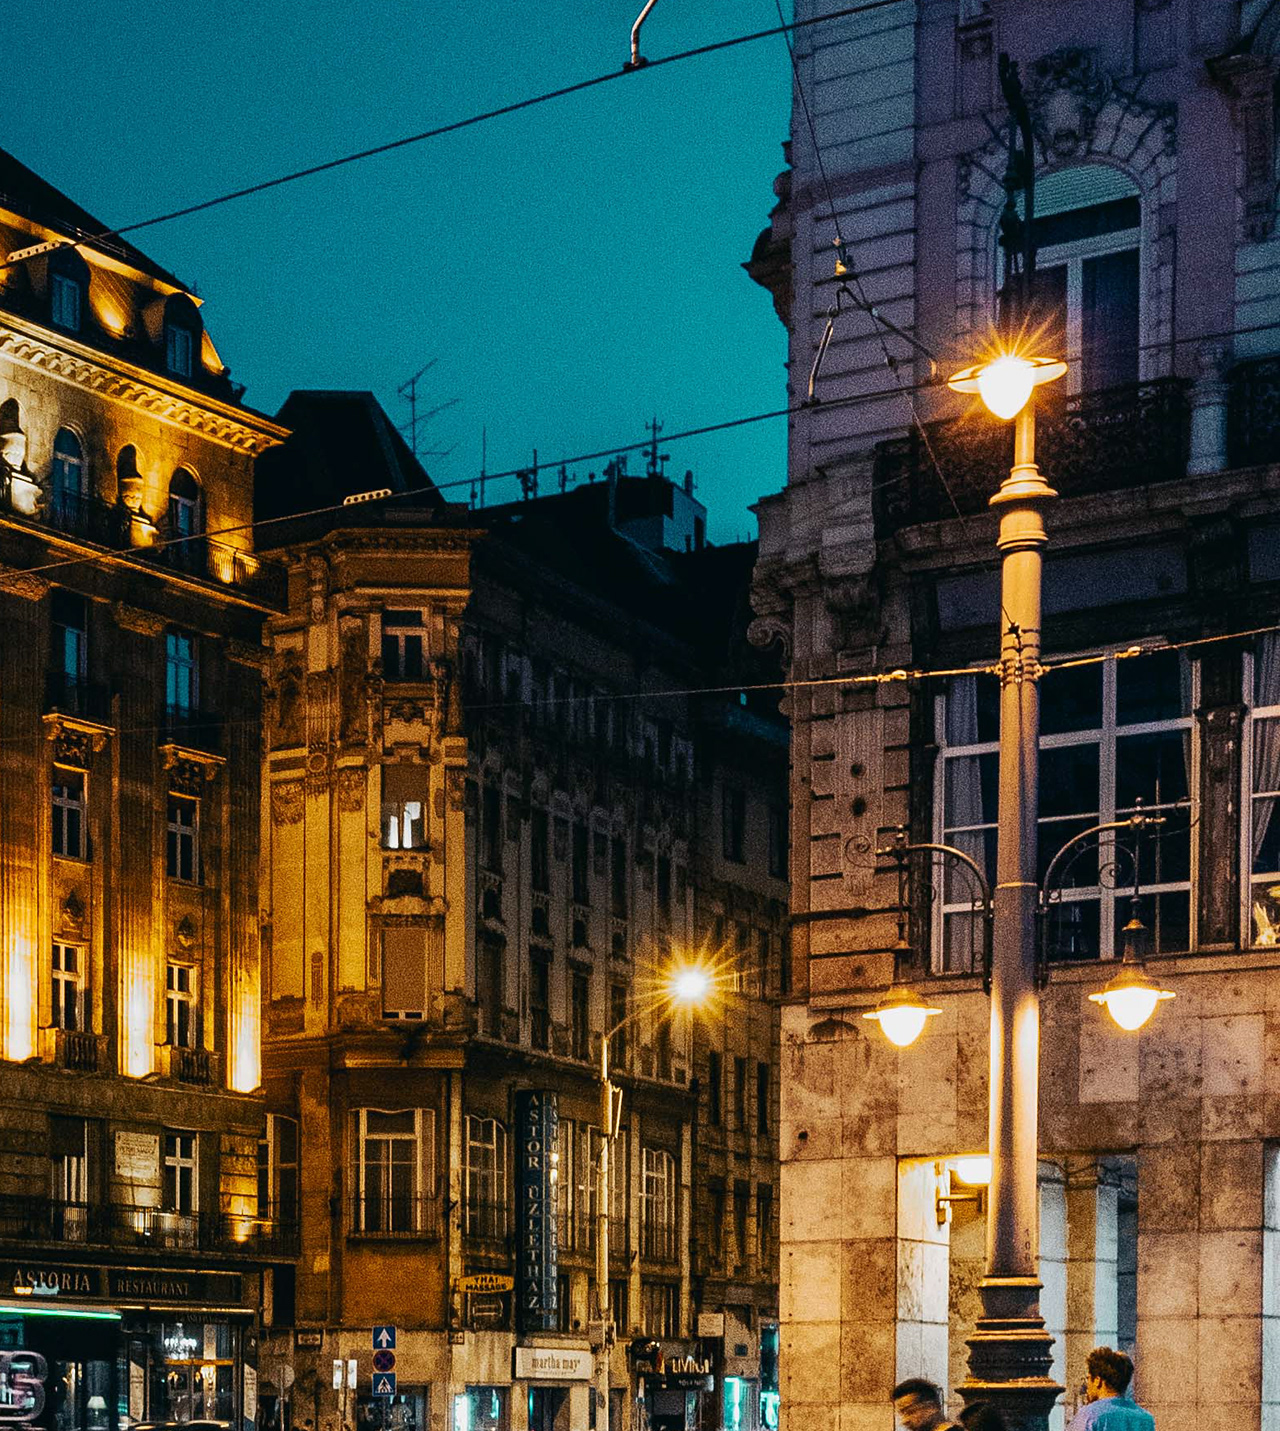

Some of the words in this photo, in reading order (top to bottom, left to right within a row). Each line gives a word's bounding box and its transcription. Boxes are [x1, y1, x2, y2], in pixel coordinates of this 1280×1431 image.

[13, 1269, 91, 1292] ASTORIA
[117, 1280, 190, 1296] RESTAURANT
[531, 1353, 560, 1369] martha
